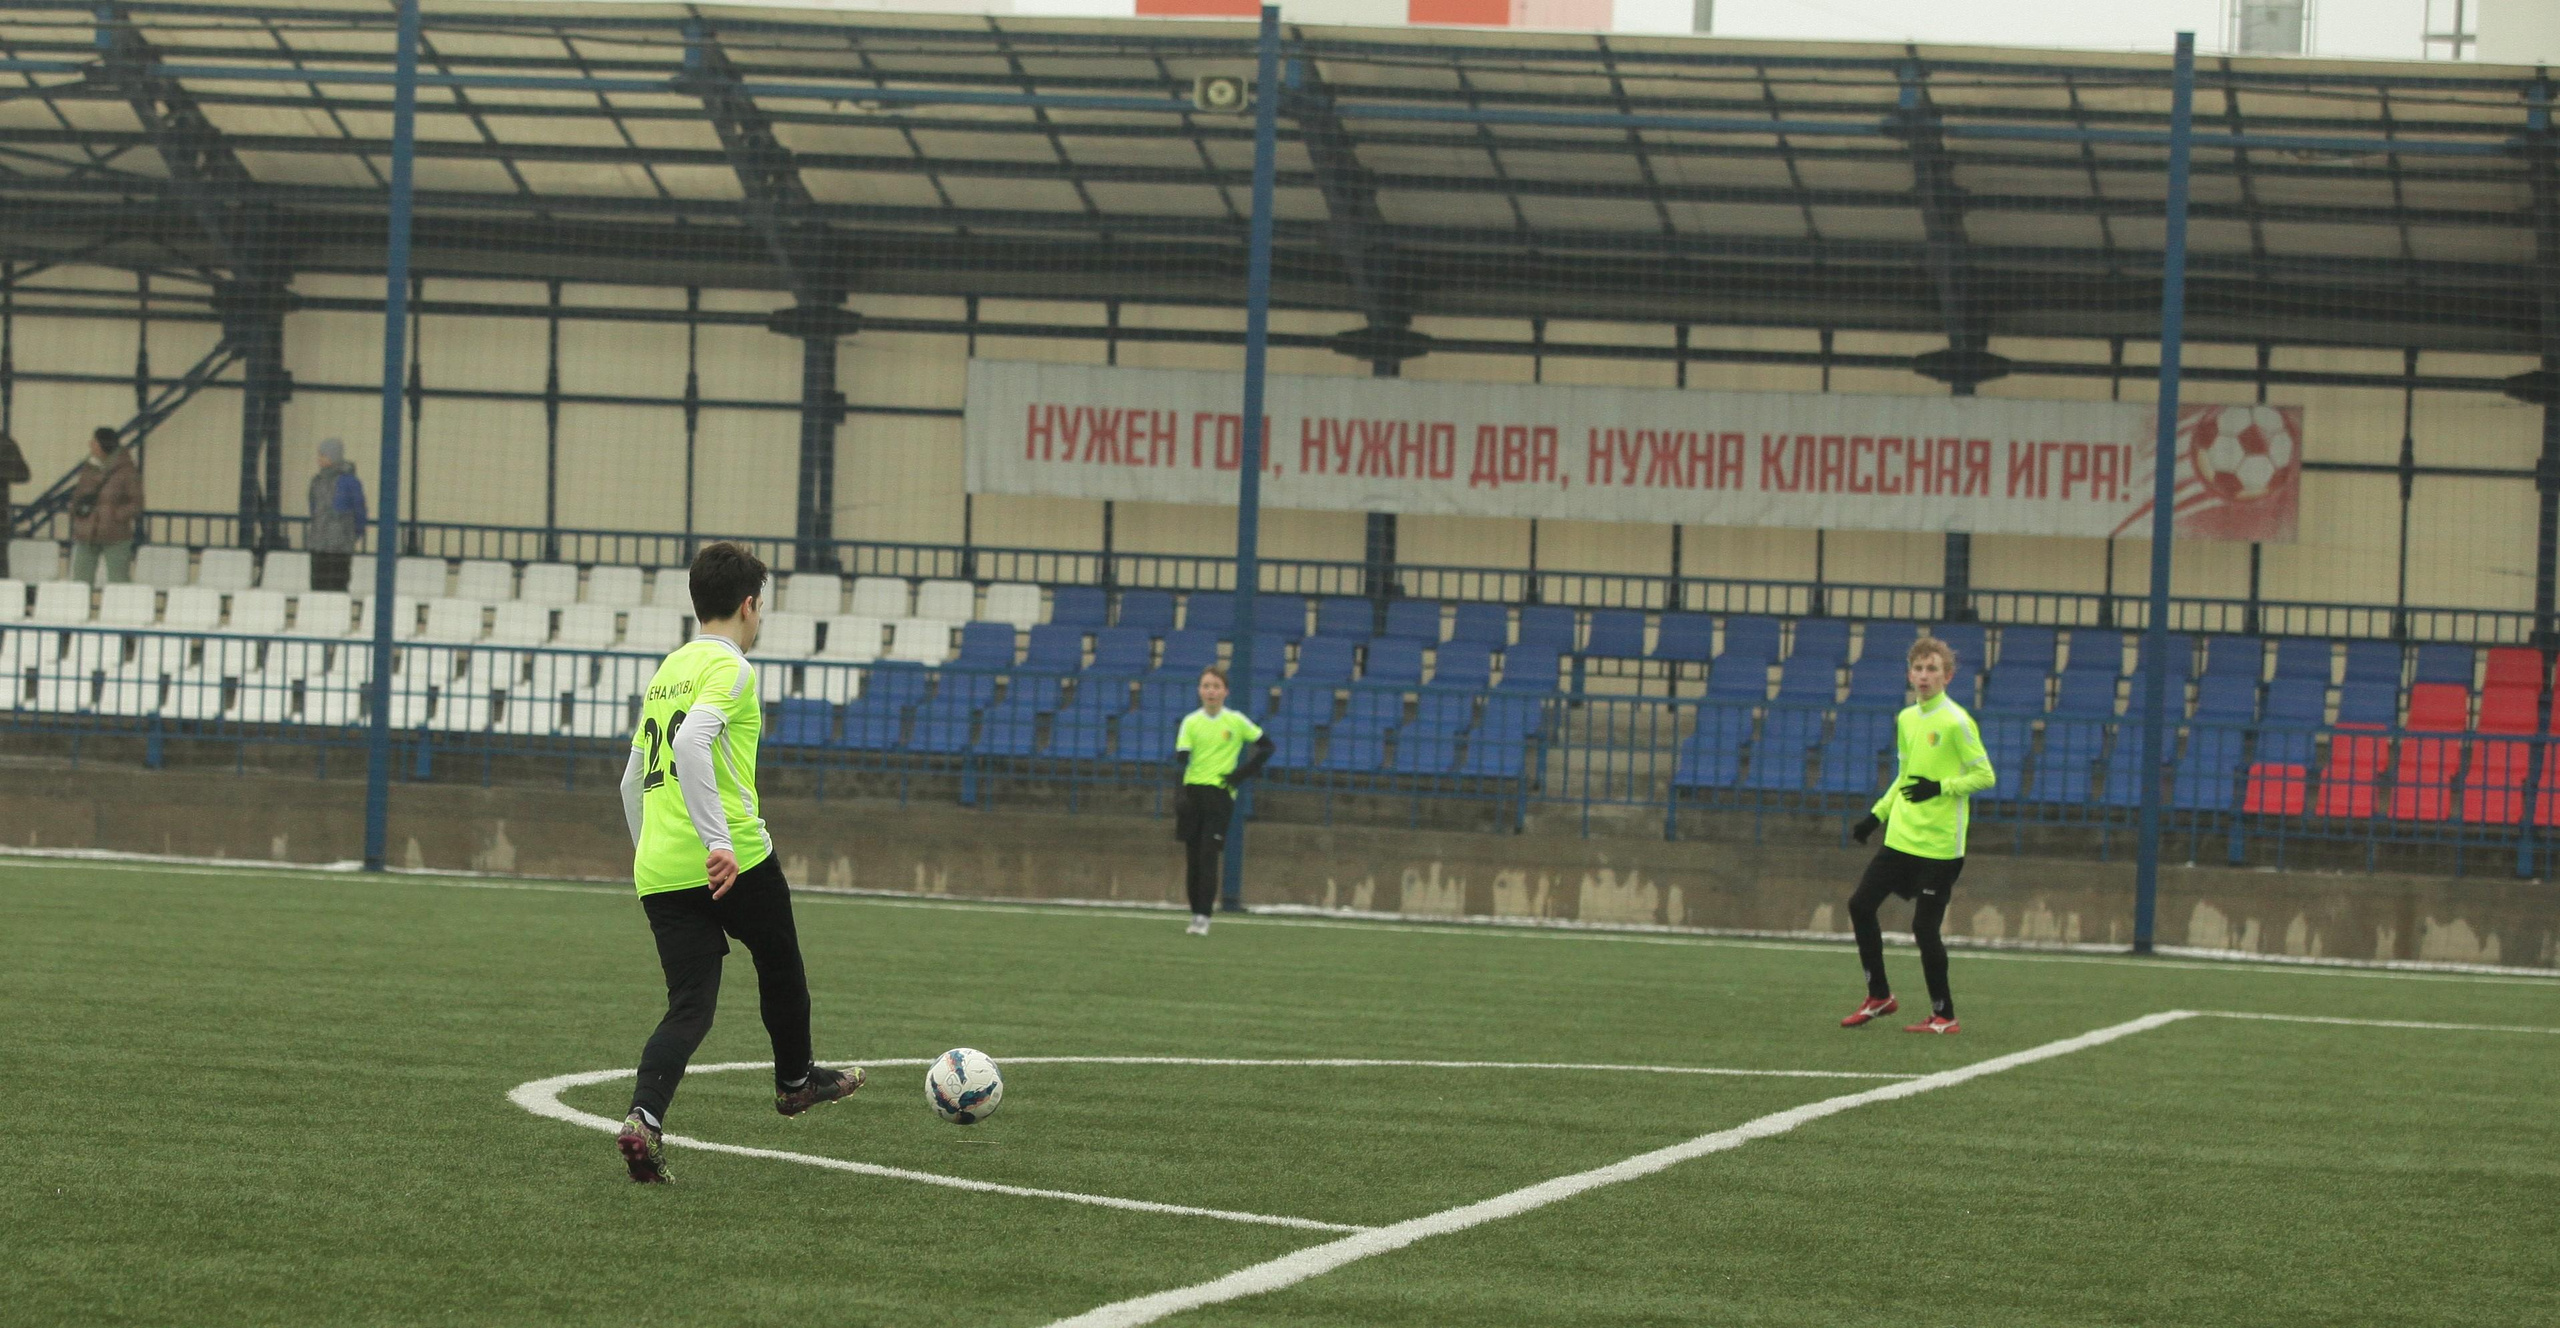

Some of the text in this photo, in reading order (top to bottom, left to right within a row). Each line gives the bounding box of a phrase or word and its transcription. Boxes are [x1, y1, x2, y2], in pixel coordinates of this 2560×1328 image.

[1025, 403, 1177, 467] НУЖЕН
[1300, 417, 1456, 480] НУЖНО
[1468, 424, 1570, 491] ДВА,
[1586, 427, 1745, 490] НУЖНА
[1760, 433, 1992, 497] КЛАССНАЯ
[2006, 440, 2133, 502] ИГРА!
[646, 685, 667, 701] ЕНА
